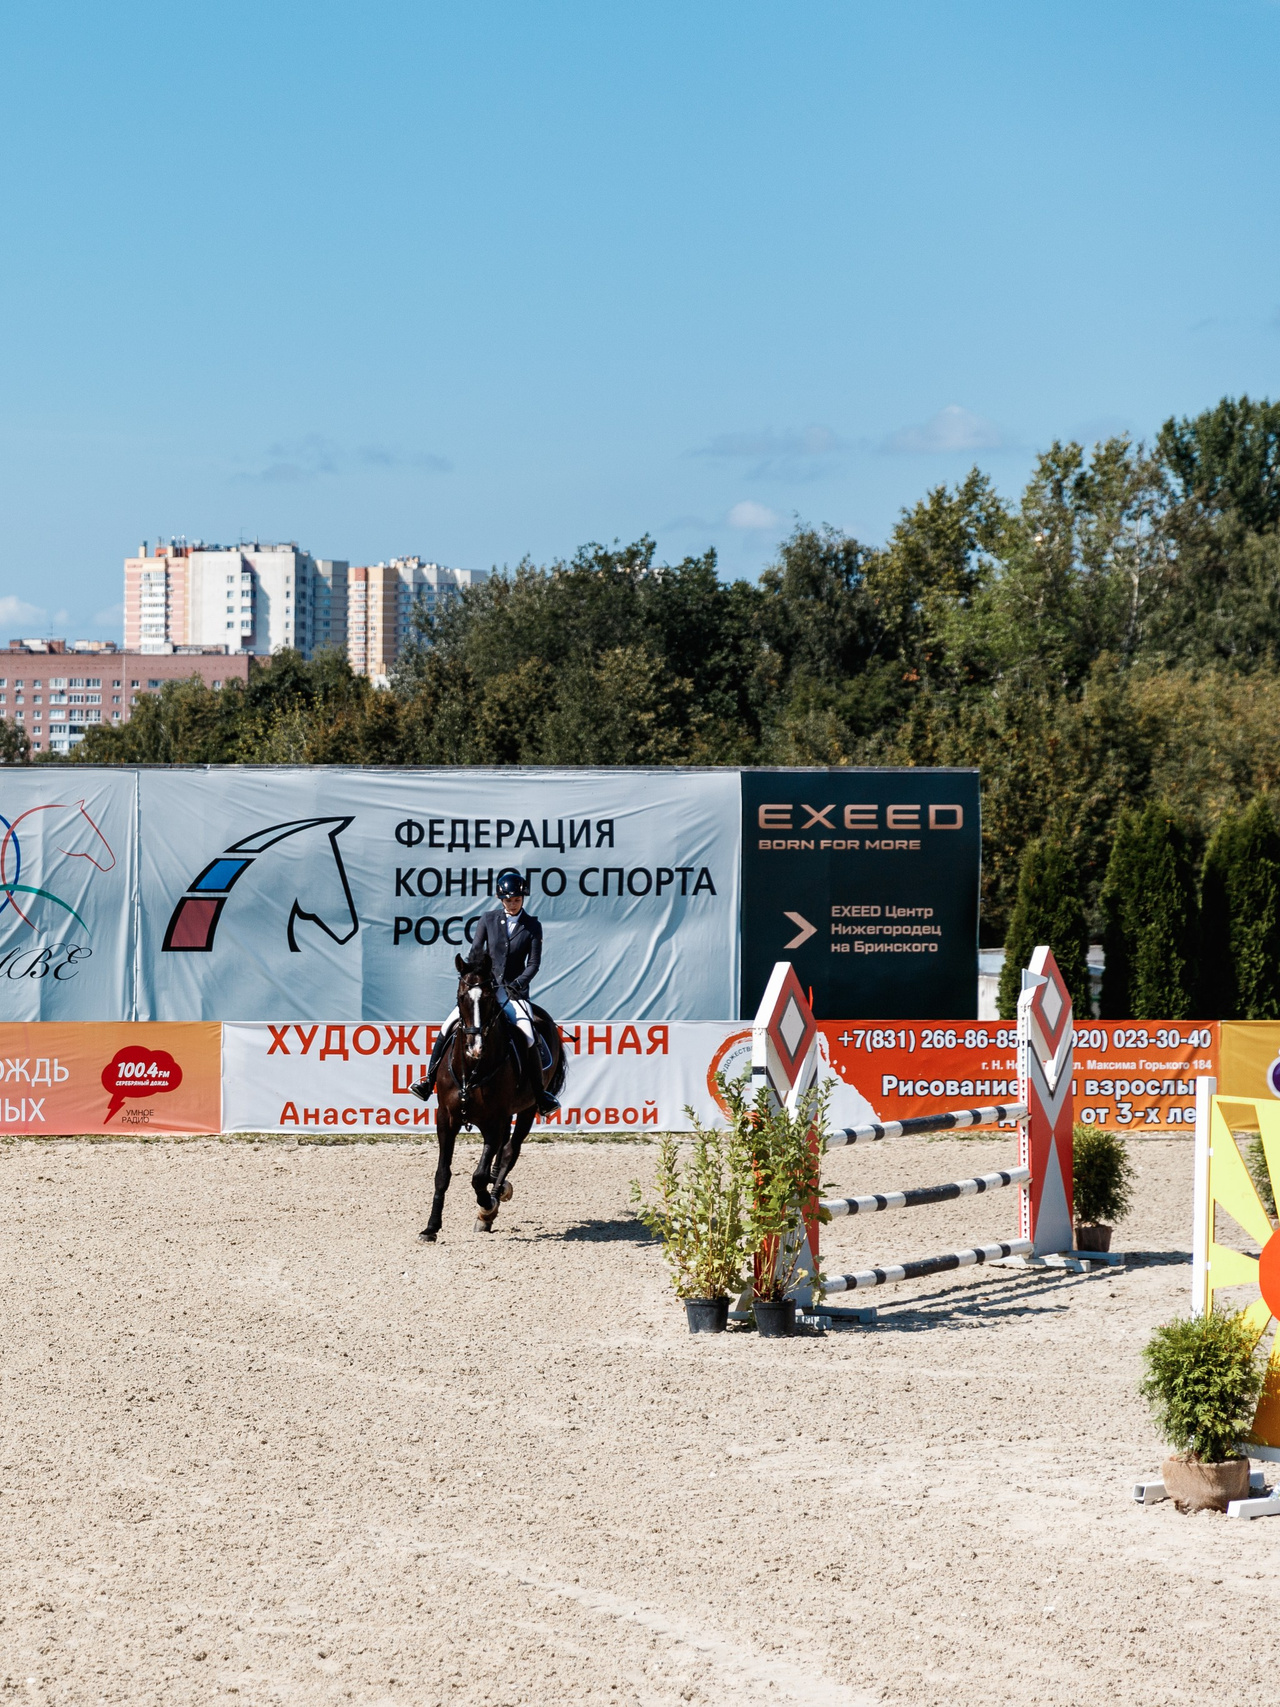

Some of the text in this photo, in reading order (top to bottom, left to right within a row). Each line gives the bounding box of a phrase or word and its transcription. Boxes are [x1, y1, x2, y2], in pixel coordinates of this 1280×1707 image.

[758, 804, 963, 830] EXEED
[394, 818, 615, 853] ФЕДЕРАЦИЯ
[758, 839, 921, 850] BORN FOR MORE
[578, 866, 718, 897] СПОРТА
[831, 905, 881, 917] EXEED
[885, 905, 934, 919] Центр
[393, 915, 538, 946] РОСС
[830, 923, 942, 937] Нижегородец
[830, 940, 939, 954] на Бринского
[837, 1028, 916, 1053] +7(831)
[920, 1028, 1021, 1050] 266-86-85
[1112, 1028, 1212, 1049] 023-30-40
[991, 1060, 1004, 1070] Н.
[1086, 1060, 1136, 1070] Максима
[1138, 1059, 1190, 1072] Горького
[1192, 1058, 1213, 1069] 184
[115, 1079, 150, 1087] СЕРЕБРЯНЫЙ
[881, 1074, 1019, 1097] Рисование
[1084, 1078, 1196, 1101] взрослы
[121, 1116, 150, 1124] РАДИО
[126, 1109, 154, 1117] УМНОЕ
[1080, 1101, 1196, 1125] от 3-х ле
